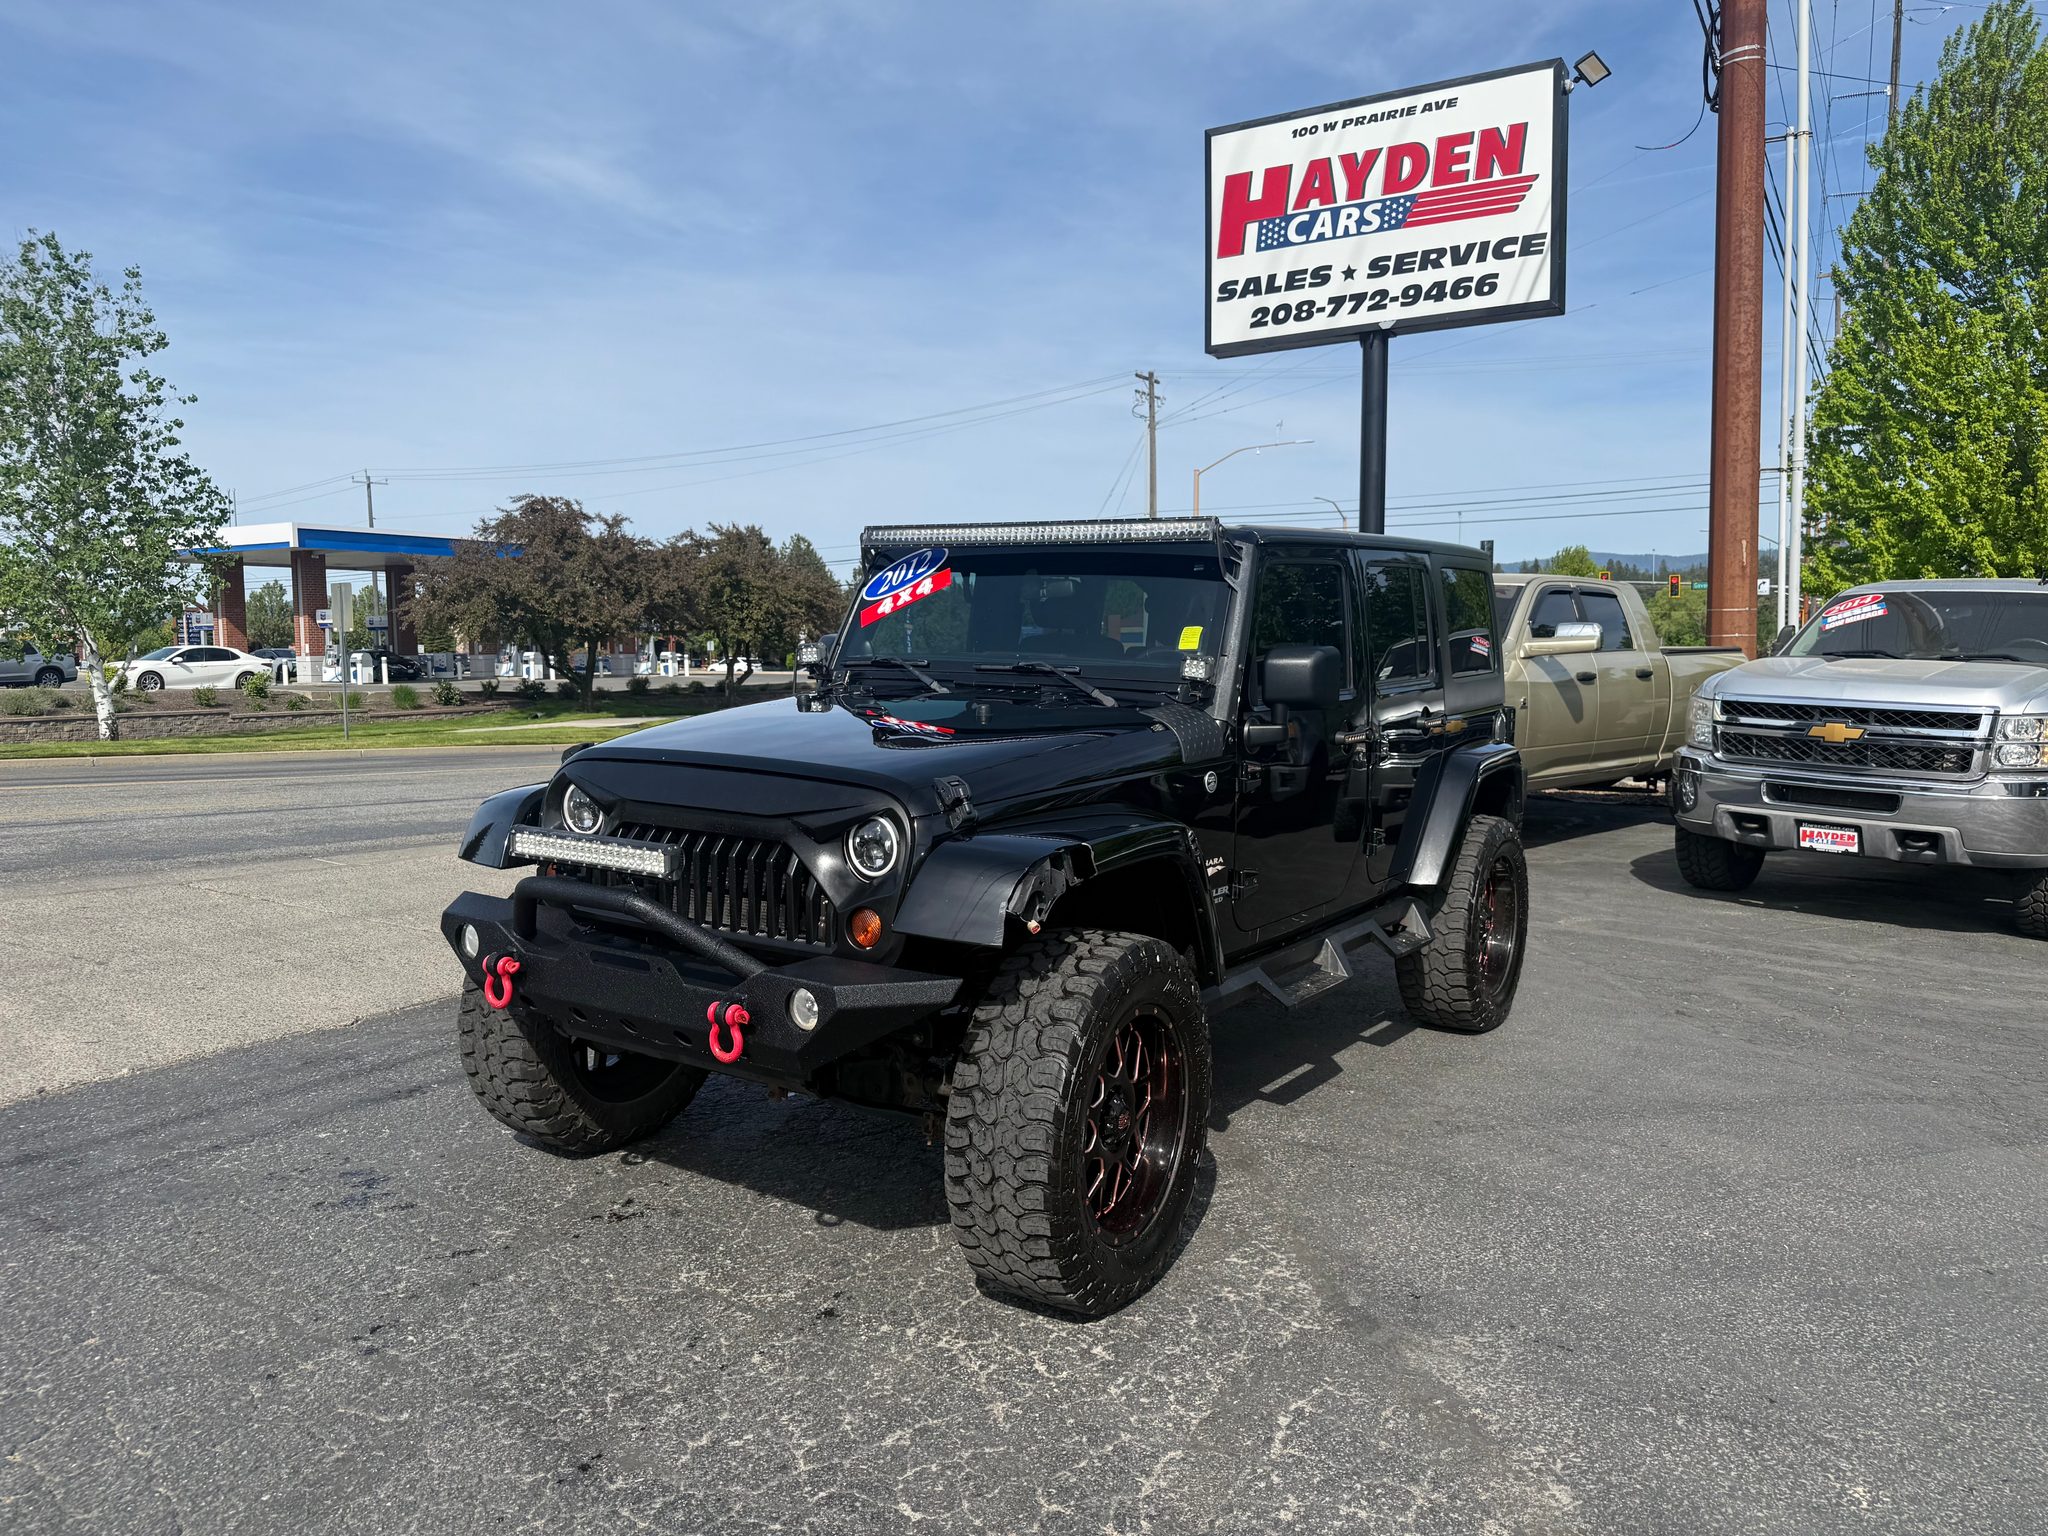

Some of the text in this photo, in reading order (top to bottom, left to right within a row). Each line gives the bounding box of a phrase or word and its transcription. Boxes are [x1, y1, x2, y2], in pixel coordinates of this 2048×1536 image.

[1291, 97, 1459, 139] 100 W PRAIRIE AVE
[1217, 122, 1529, 259] HAYDEN
[1286, 202, 1383, 245] CARS
[1217, 232, 1548, 302] SALES SERVICE
[1250, 273, 1500, 330] 208-772-9466
[877, 550, 933, 595] 2012
[1801, 829, 1856, 843] HAYDEN
